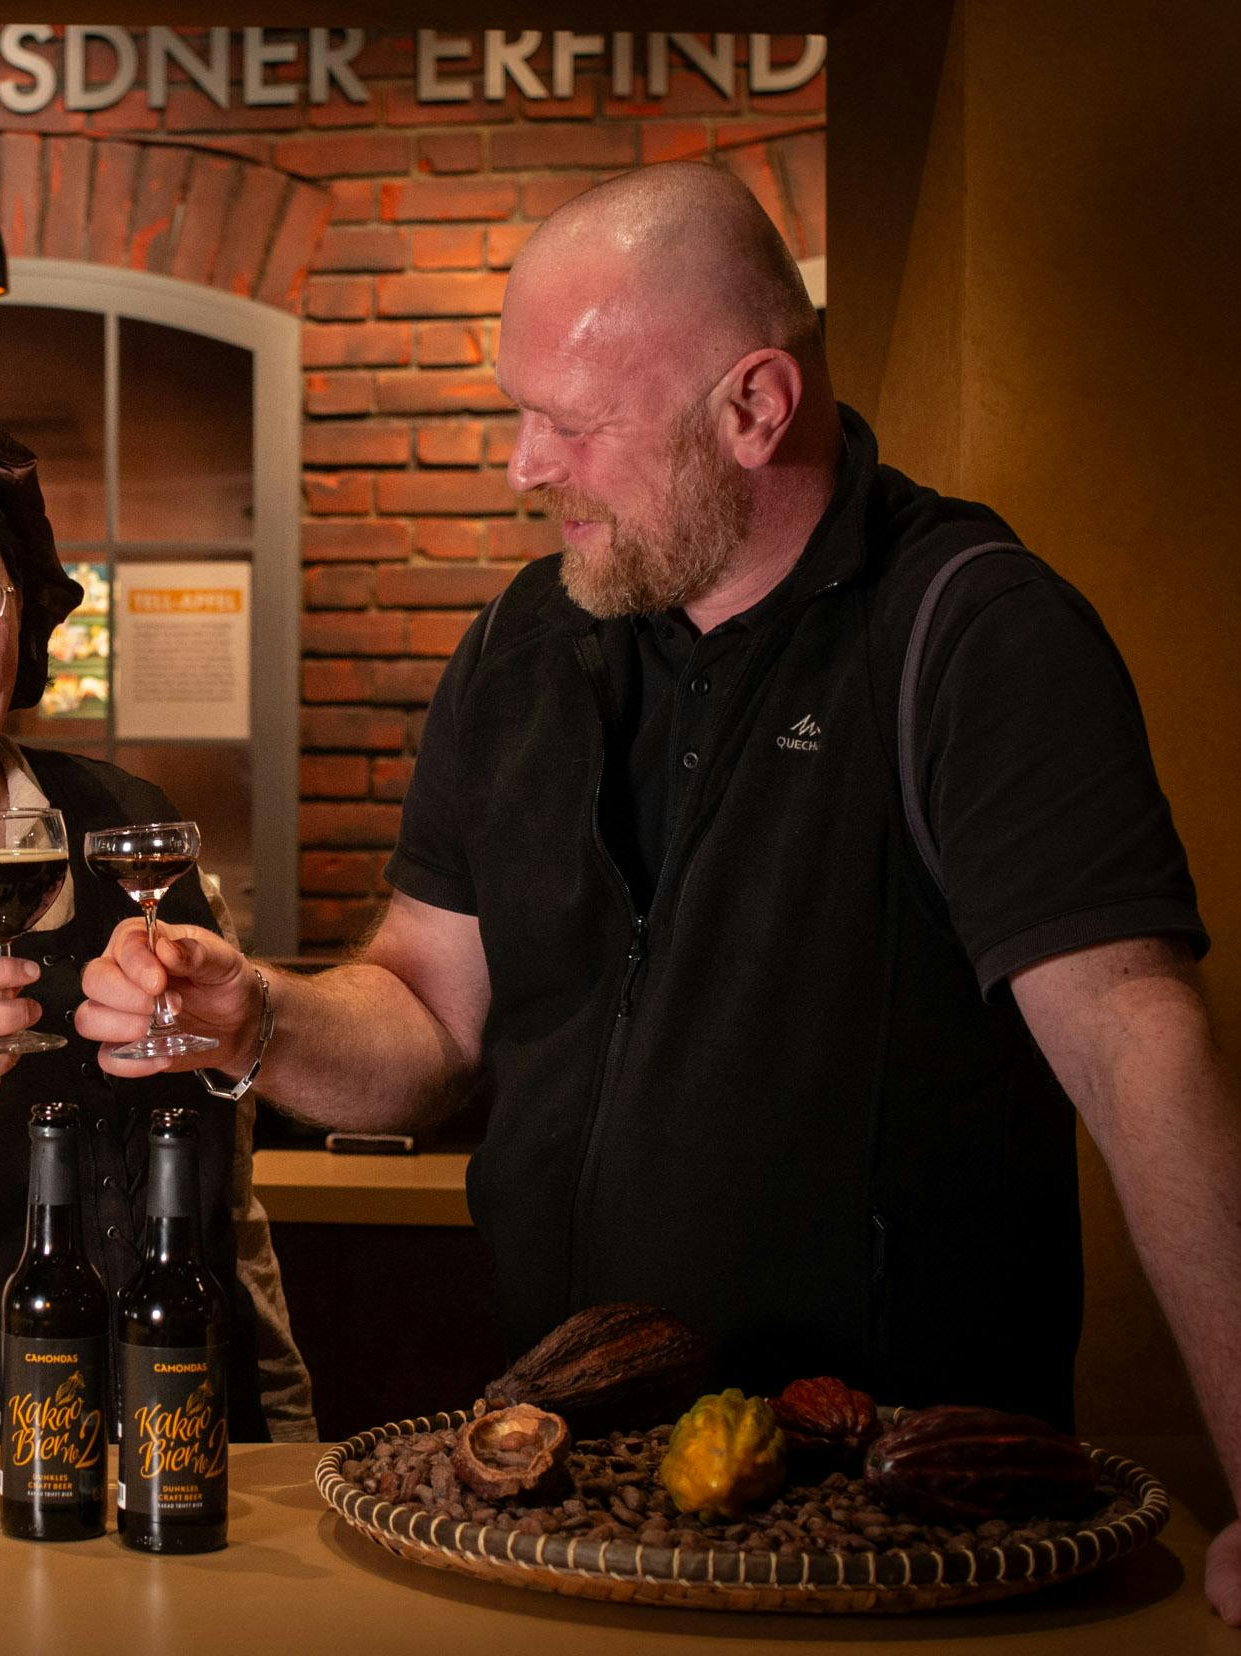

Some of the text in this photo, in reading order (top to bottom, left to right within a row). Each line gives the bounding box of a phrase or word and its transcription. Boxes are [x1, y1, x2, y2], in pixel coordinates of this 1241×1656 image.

[418, 29, 827, 101] ERFIND
[24, 1353, 78, 1363] CAMONDAS
[154, 1363, 208, 1373] CAMONDAS
[8, 1393, 83, 1433] Kakao
[134, 1403, 211, 1443] Kakao
[12, 1428, 69, 1466] Bier
[75, 1409, 101, 1469] 2
[138, 1439, 200, 1478] Bier
[204, 1418, 227, 1479] 2
[27, 1481, 73, 1491] CRAFT BEER
[158, 1493, 203, 1502] CRAFT BEER
[162, 1485, 198, 1493] DUNKLES
